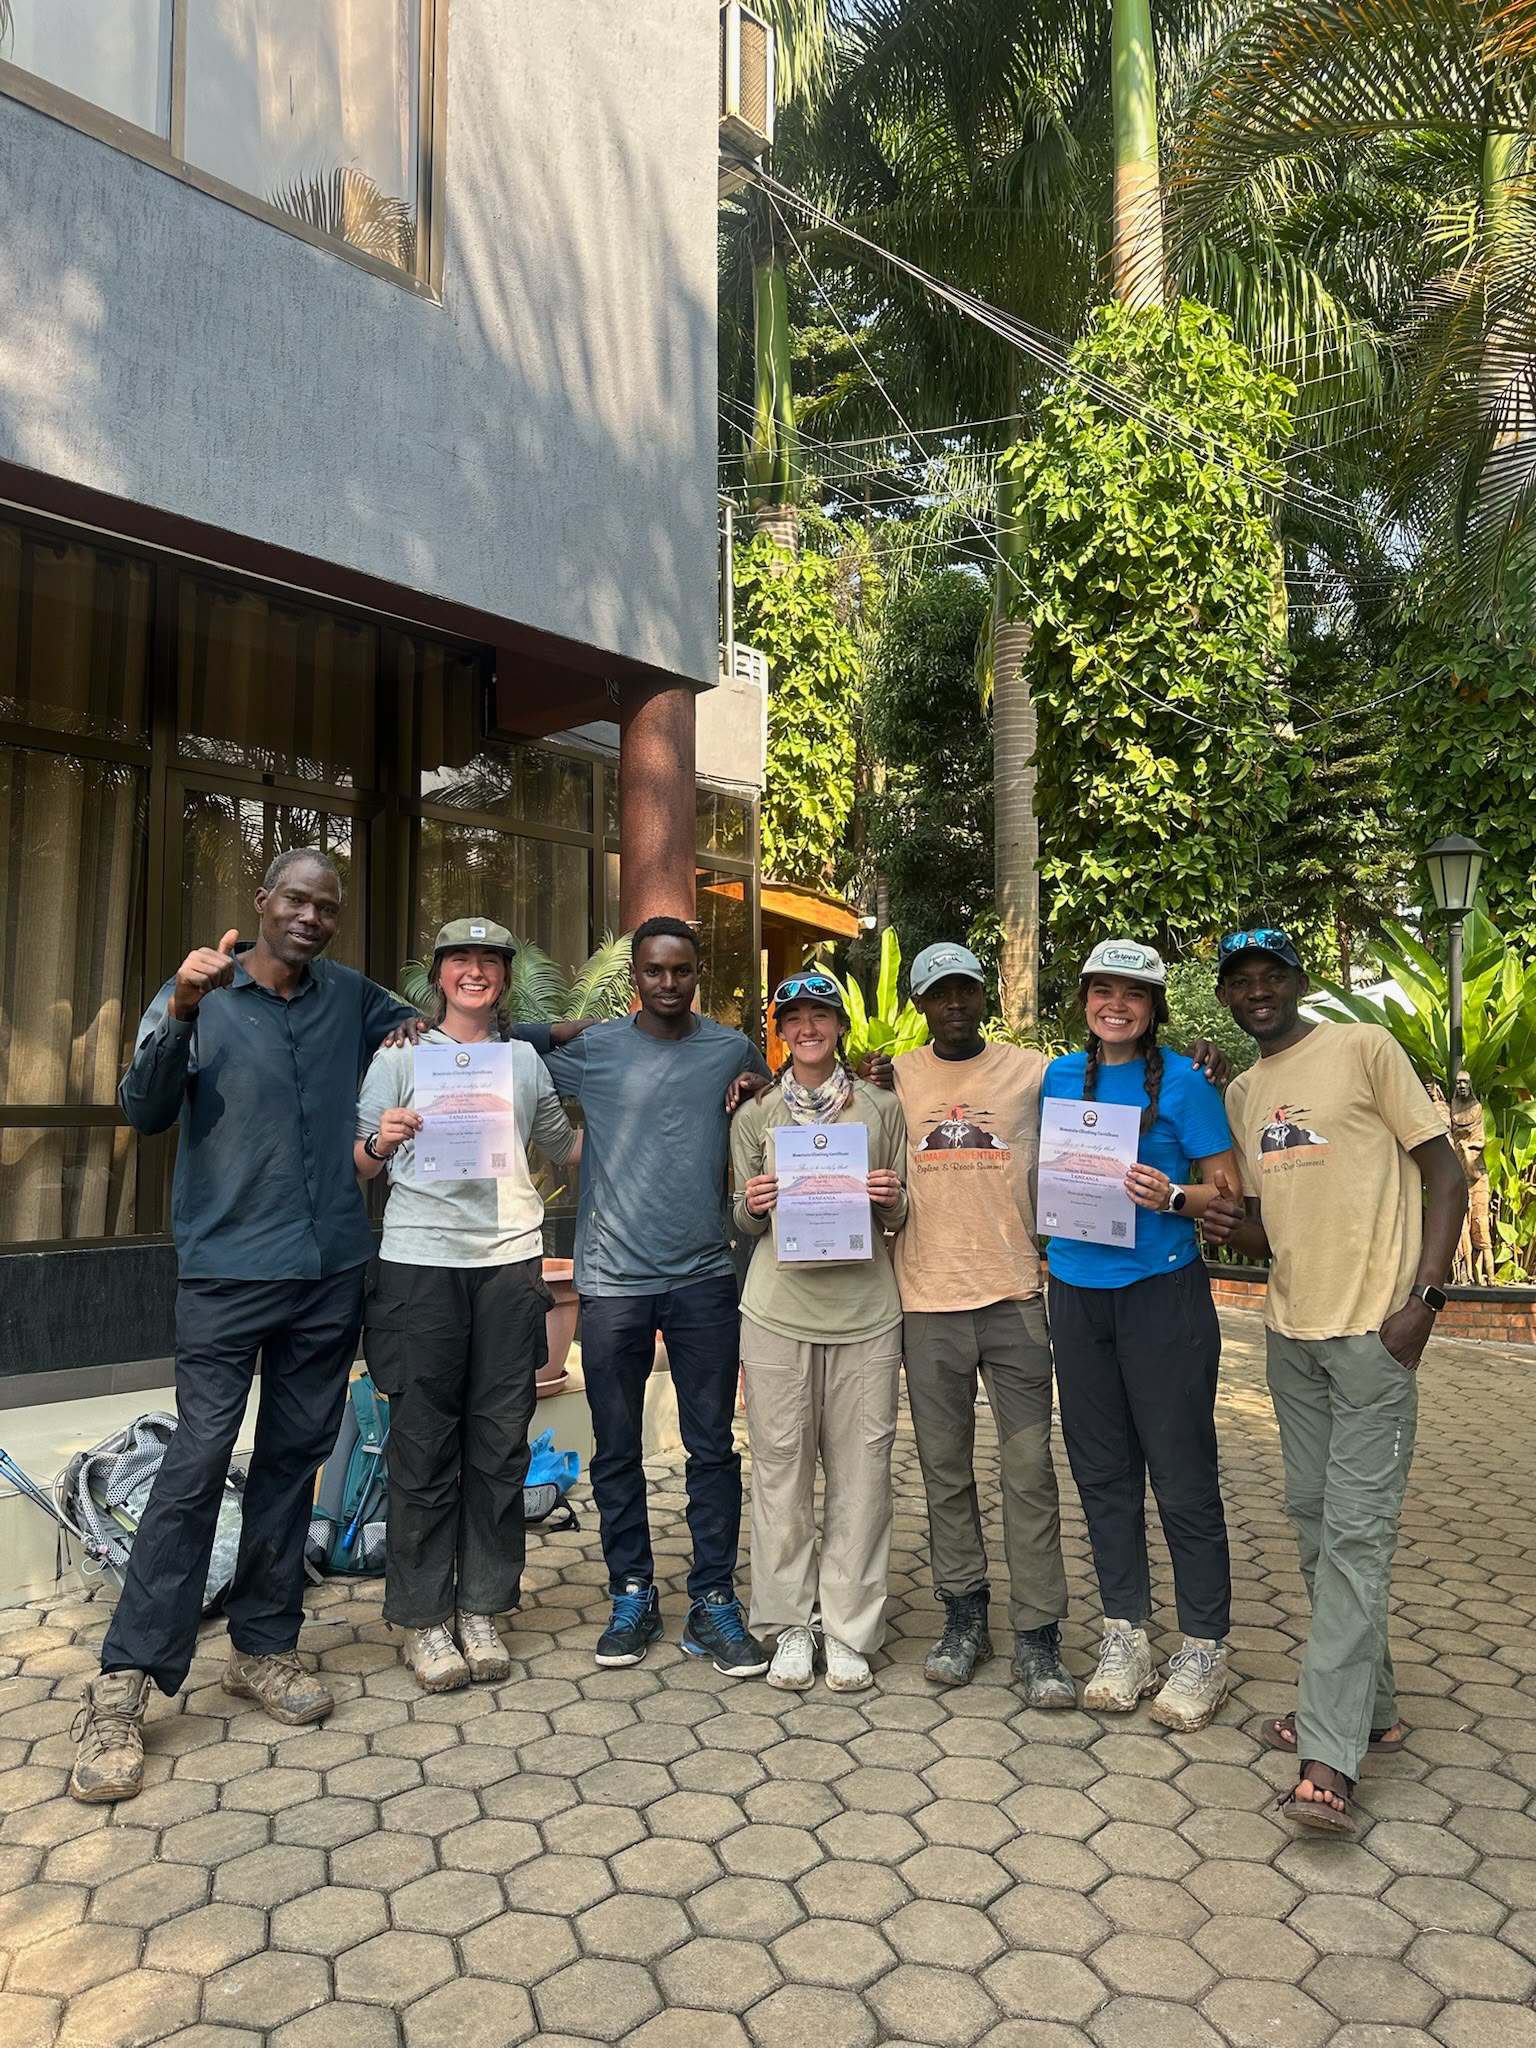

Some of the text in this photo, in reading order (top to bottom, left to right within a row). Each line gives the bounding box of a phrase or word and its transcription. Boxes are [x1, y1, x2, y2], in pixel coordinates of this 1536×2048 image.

[1107, 950, 1140, 960] Carport
[954, 1150, 1011, 1161] ADVENTURES
[917, 1164, 939, 1174] Explore
[950, 1162, 975, 1170] Reach
[976, 1161, 1004, 1170] Summit
[1296, 1159, 1325, 1167] Summit
